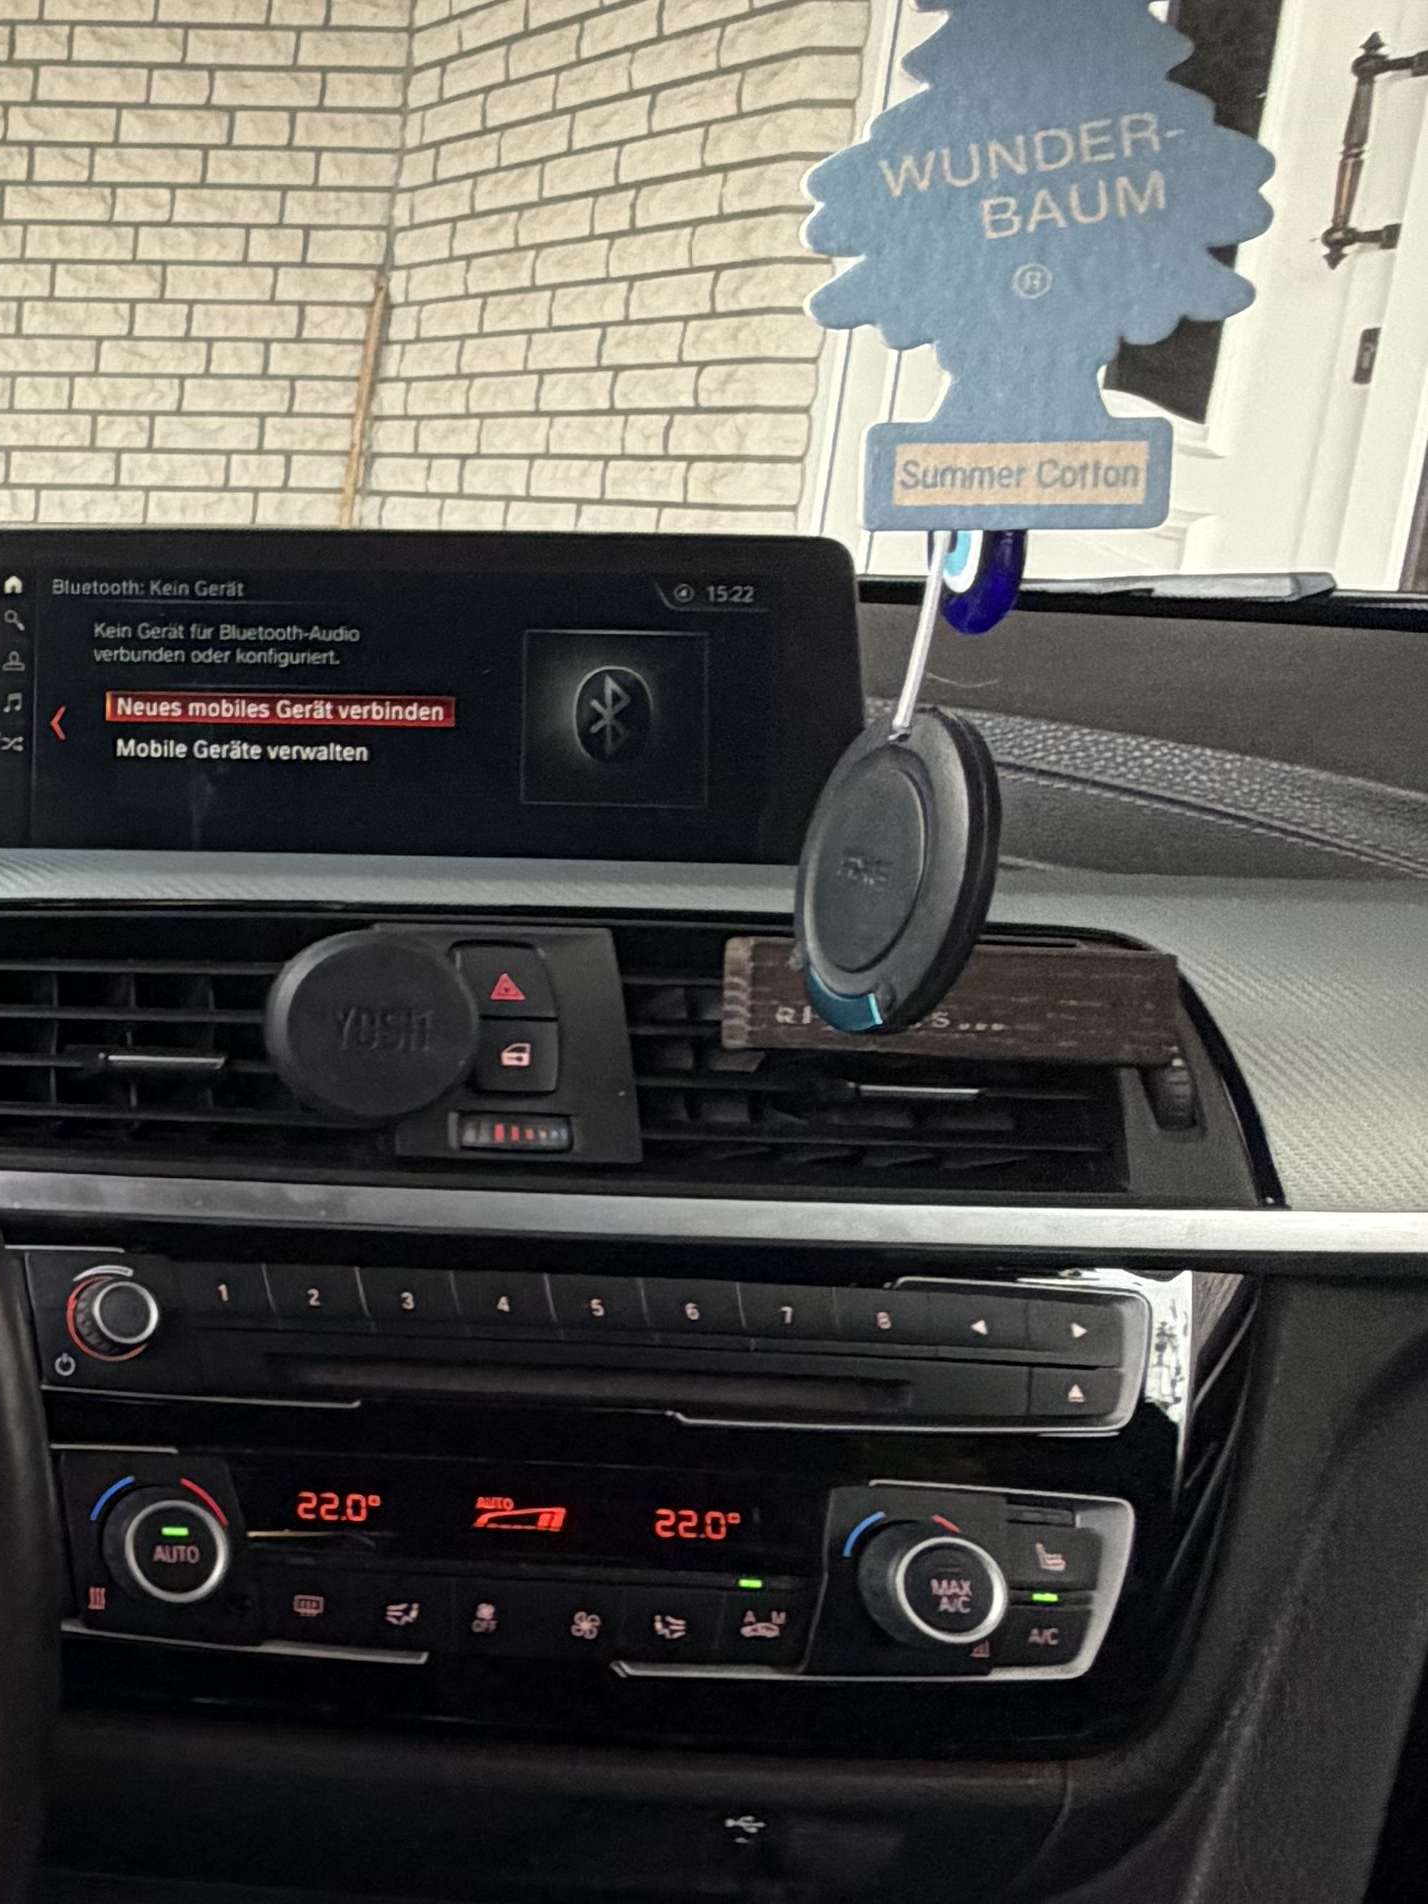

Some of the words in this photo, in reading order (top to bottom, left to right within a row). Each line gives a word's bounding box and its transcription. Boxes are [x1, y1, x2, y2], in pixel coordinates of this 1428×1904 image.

[879, 111, 1184, 200] WUNDER-
[981, 170, 1168, 241] BAUM
[898, 459, 1027, 493] Summer
[1034, 458, 1141, 492] Cotton
[52, 579, 145, 596] Bluetooth:
[149, 580, 190, 596] Kein
[194, 580, 244, 597] Gerät
[93, 624, 132, 639] Kein
[137, 624, 184, 640] Gerät
[190, 623, 214, 641] für
[219, 625, 360, 642] Bluetooth-Audio
[93, 647, 185, 663] verbunden
[190, 647, 230, 664] oder
[235, 648, 340, 668] konfiguriert.
[116, 697, 183, 718] Neues
[188, 698, 270, 719] mobiles
[276, 699, 333, 720] Gerät
[338, 701, 444, 722] verbinden
[116, 738, 187, 759] Mobile
[192, 739, 262, 760] Geräte
[268, 741, 368, 762] verwalten
[217, 1284, 229, 1302] 1
[307, 1288, 321, 1307] 2
[401, 1291, 415, 1310] 3
[496, 1296, 510, 1313] 4
[590, 1298, 605, 1317] 5
[685, 1302, 700, 1321] 6
[780, 1305, 794, 1324] 7
[877, 1311, 892, 1330] 8
[475, 1497, 514, 1511] AUTO
[153, 1544, 200, 1565] AUTO
[930, 1579, 971, 1597] MAX
[938, 1596, 971, 1614] A/C
[1028, 1628, 1059, 1645] A/C
